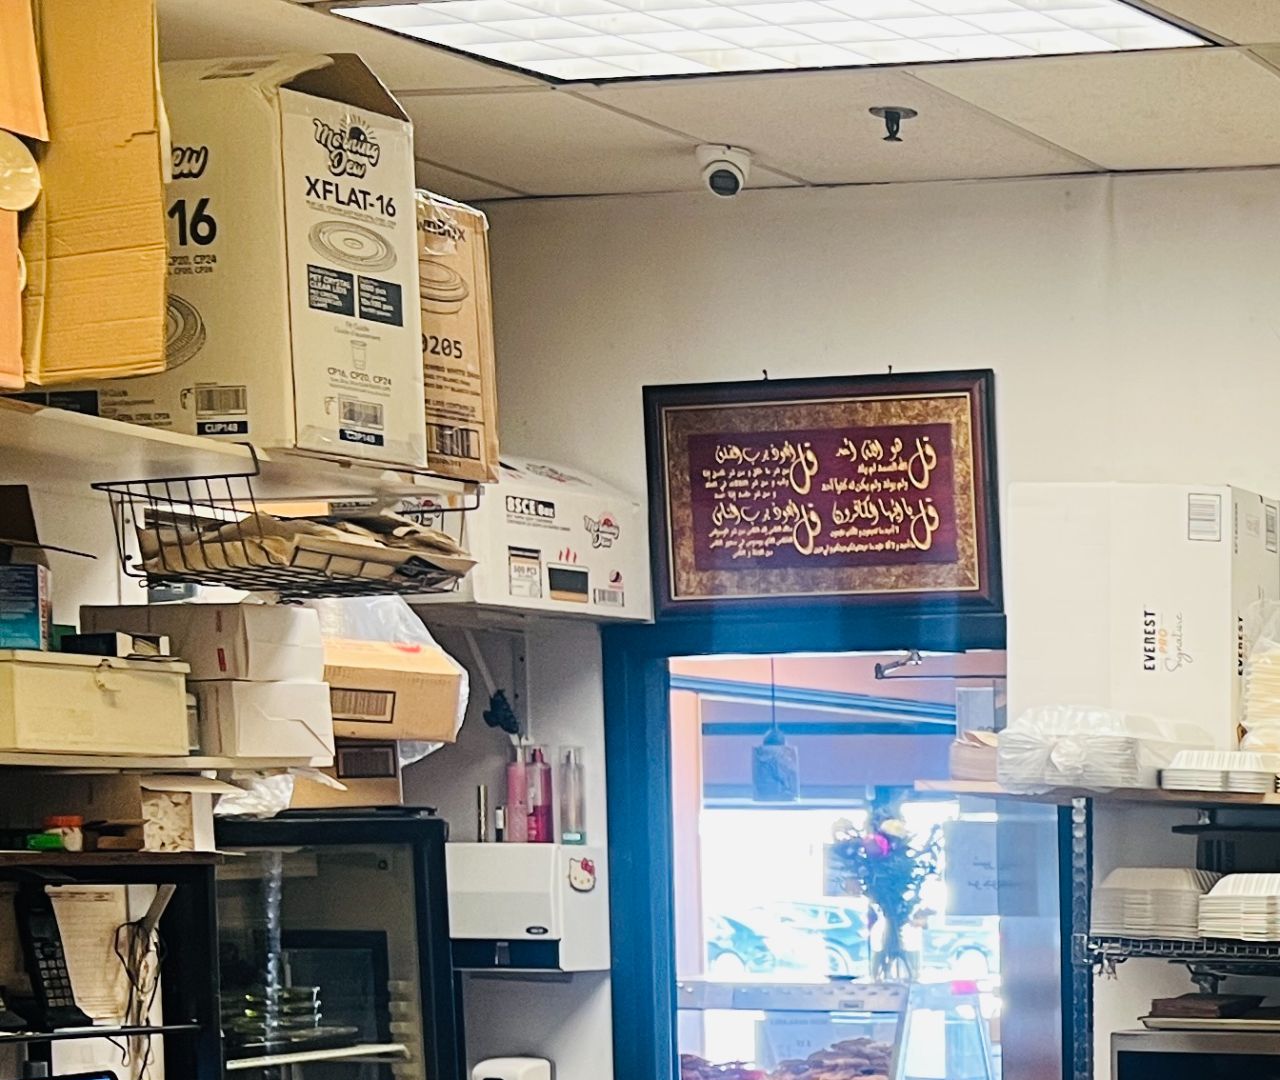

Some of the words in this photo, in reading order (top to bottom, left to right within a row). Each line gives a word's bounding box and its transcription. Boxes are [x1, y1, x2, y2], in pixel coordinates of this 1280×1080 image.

[171, 145, 209, 180] ew
[313, 118, 380, 167] Morning
[329, 149, 366, 179] Dew
[305, 176, 397, 218] XFLAT-16
[1143, 610, 1156, 671] EVEREST
[1164, 611, 1193, 672] Signature
